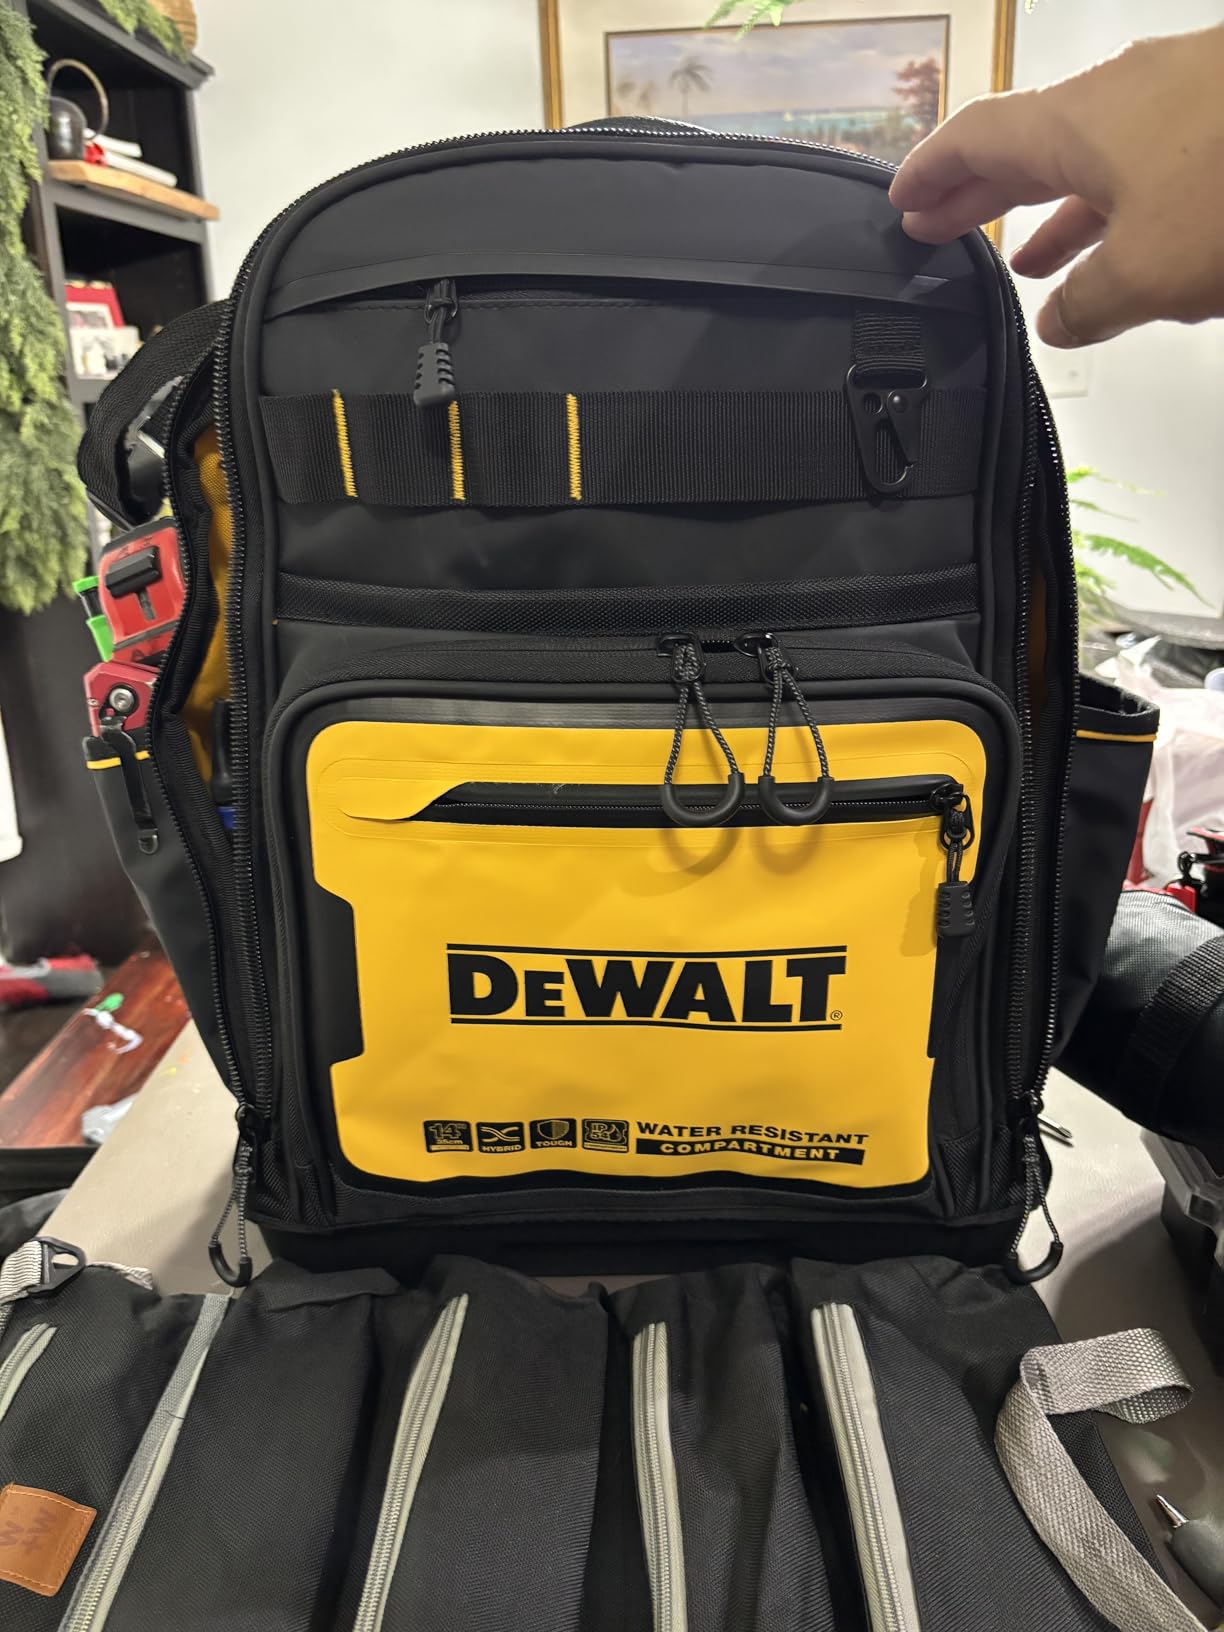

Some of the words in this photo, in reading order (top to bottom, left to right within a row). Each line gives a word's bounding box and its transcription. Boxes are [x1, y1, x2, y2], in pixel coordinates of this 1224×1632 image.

[636, 1121, 722, 1137] WATER
[731, 1124, 869, 1145] RESISTANT
[481, 1144, 522, 1152] HYBRID
[660, 1140, 840, 1160] COMPARTMENT
